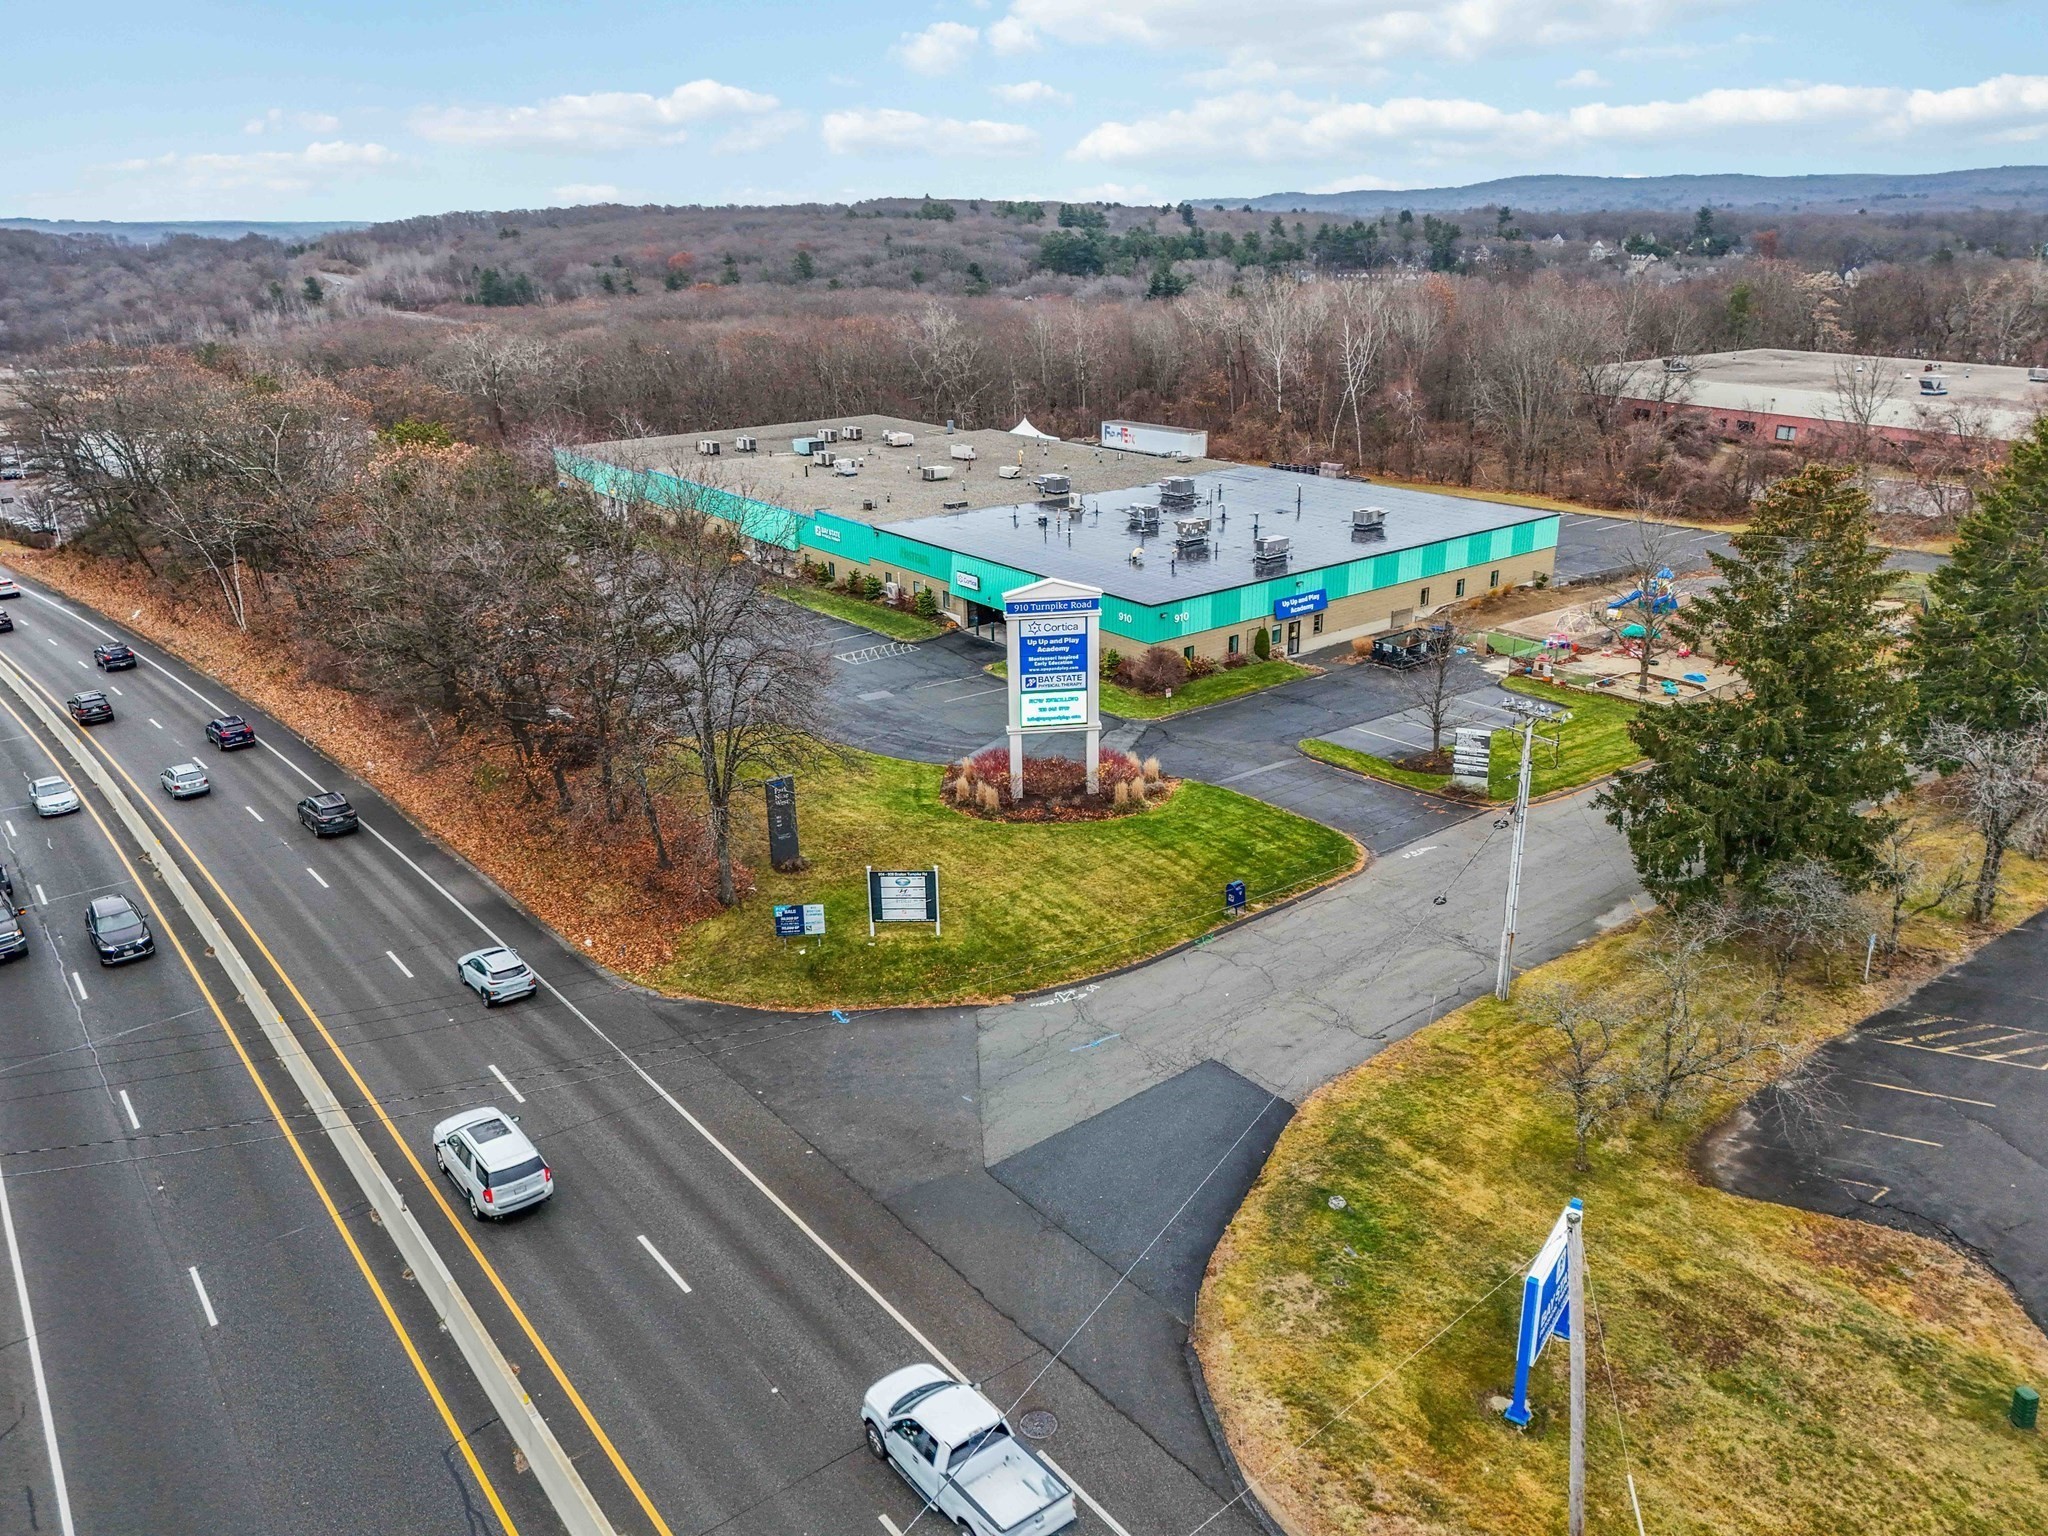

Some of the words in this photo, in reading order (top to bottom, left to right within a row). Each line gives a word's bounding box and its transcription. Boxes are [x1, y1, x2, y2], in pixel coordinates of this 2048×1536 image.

[1014, 603, 1029, 612] 910
[1030, 602, 1068, 612] Turnpike
[1070, 600, 1092, 609] Road
[1281, 600, 1290, 608] Up
[1298, 595, 1308, 603] and
[1308, 593, 1320, 601] Play
[1290, 603, 1314, 614] Academy
[1118, 612, 1132, 623] 910
[1174, 612, 1189, 623] 910
[1043, 622, 1079, 632] Cortica
[1063, 637, 1080, 645] Play
[1037, 645, 1070, 653] Academy
[1038, 675, 1056, 683] BAY
[1056, 674, 1083, 682] STATE
